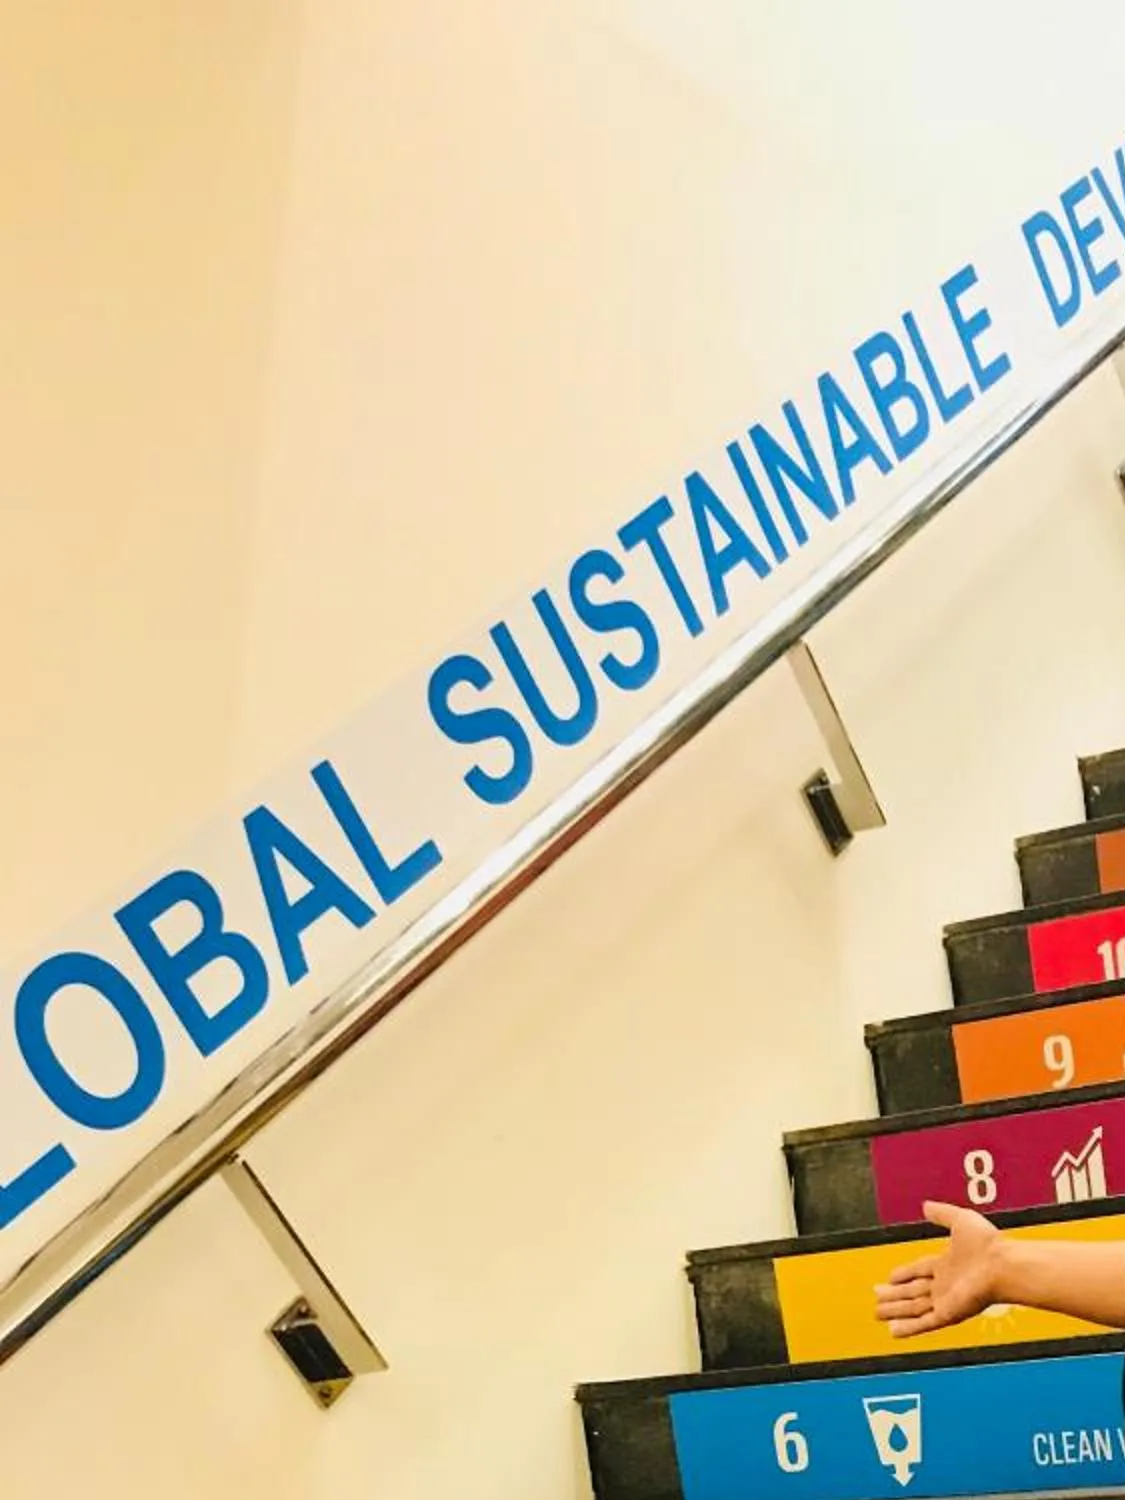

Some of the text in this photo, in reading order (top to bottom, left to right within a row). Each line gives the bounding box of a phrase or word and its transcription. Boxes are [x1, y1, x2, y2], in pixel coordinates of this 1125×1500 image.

[0, 760, 442, 1229] OBAL
[428, 264, 1011, 805] SUSTAINABLE
[1043, 1035, 1075, 1089] 9
[963, 1149, 997, 1205] 8
[773, 1412, 809, 1472] 6
[1033, 1428, 1113, 1466] CLEAN
